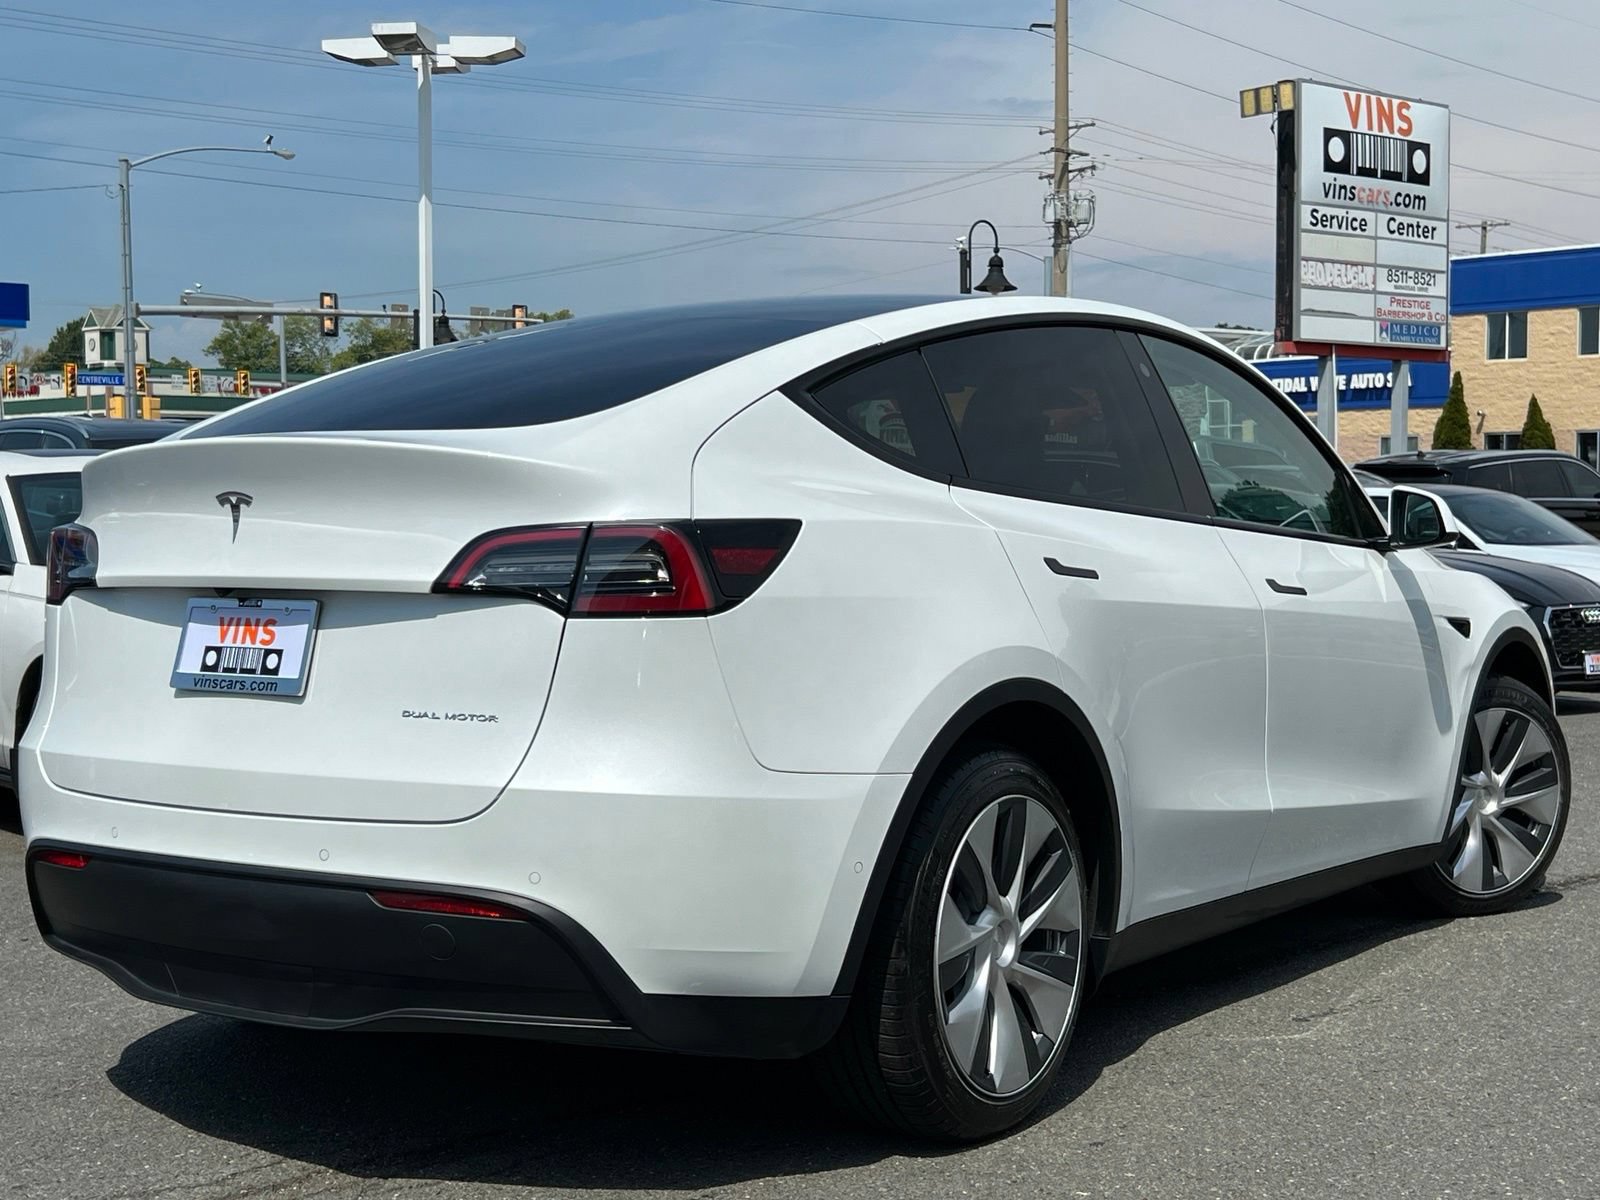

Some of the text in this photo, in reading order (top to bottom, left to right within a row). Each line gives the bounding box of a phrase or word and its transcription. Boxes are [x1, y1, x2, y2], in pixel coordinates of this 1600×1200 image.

[1343, 91, 1413, 137] VINS
[1322, 177, 1427, 211] vinscars.com
[1309, 208, 1437, 240] Service Center
[1386, 268, 1436, 287] 8511-8521
[1389, 296, 1431, 311] PRESTIGE
[1376, 307, 1426, 320] BARBERSHOP
[1427, 311, 1433, 321] &
[1392, 323, 1439, 336] MEDICO
[78, 376, 120, 384] CENTREVILLE
[1350, 372, 1384, 389] AUTO
[218, 616, 279, 647] VINS
[193, 674, 279, 693] vinscars.com
[402, 709, 499, 724] DUAL MOTOR
